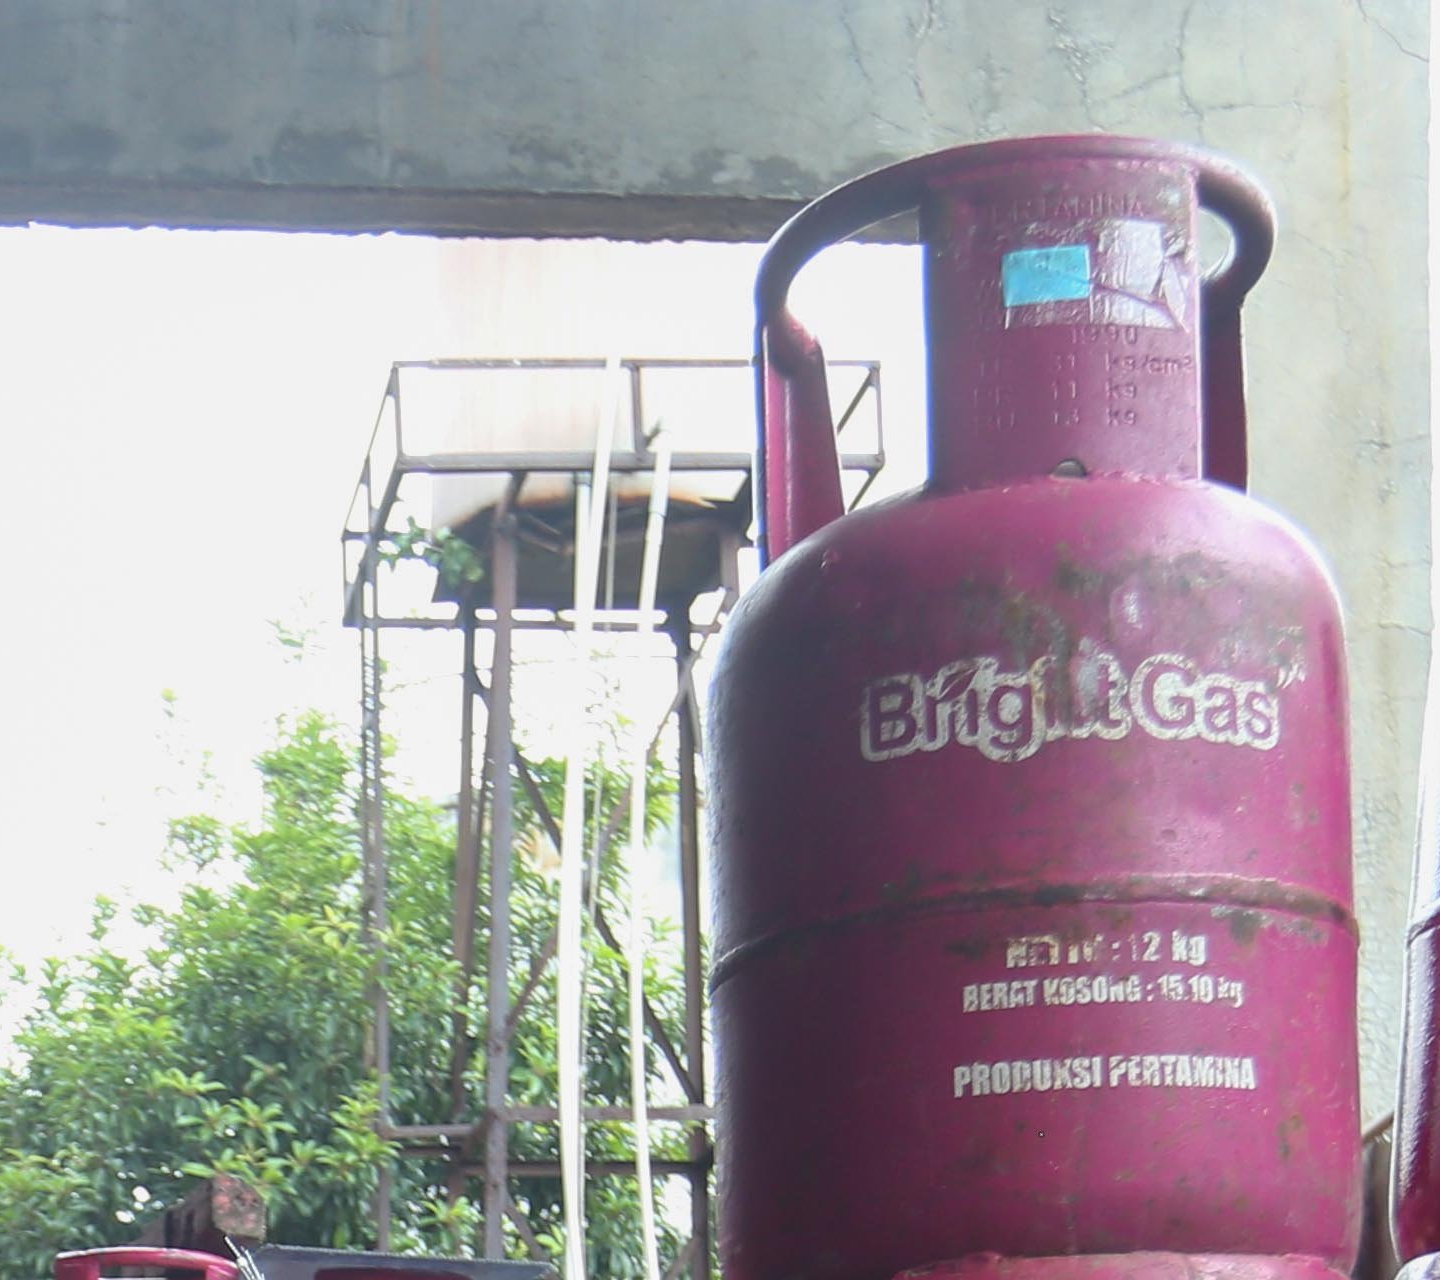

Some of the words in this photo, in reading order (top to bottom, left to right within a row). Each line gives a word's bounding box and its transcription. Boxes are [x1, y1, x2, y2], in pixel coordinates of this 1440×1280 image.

[1171, 929, 1207, 967] kg
[962, 979, 1039, 1013] BERAT
[953, 1056, 1103, 1099] PRODUKSI
[1108, 1054, 1258, 1091] PERTAMINA
